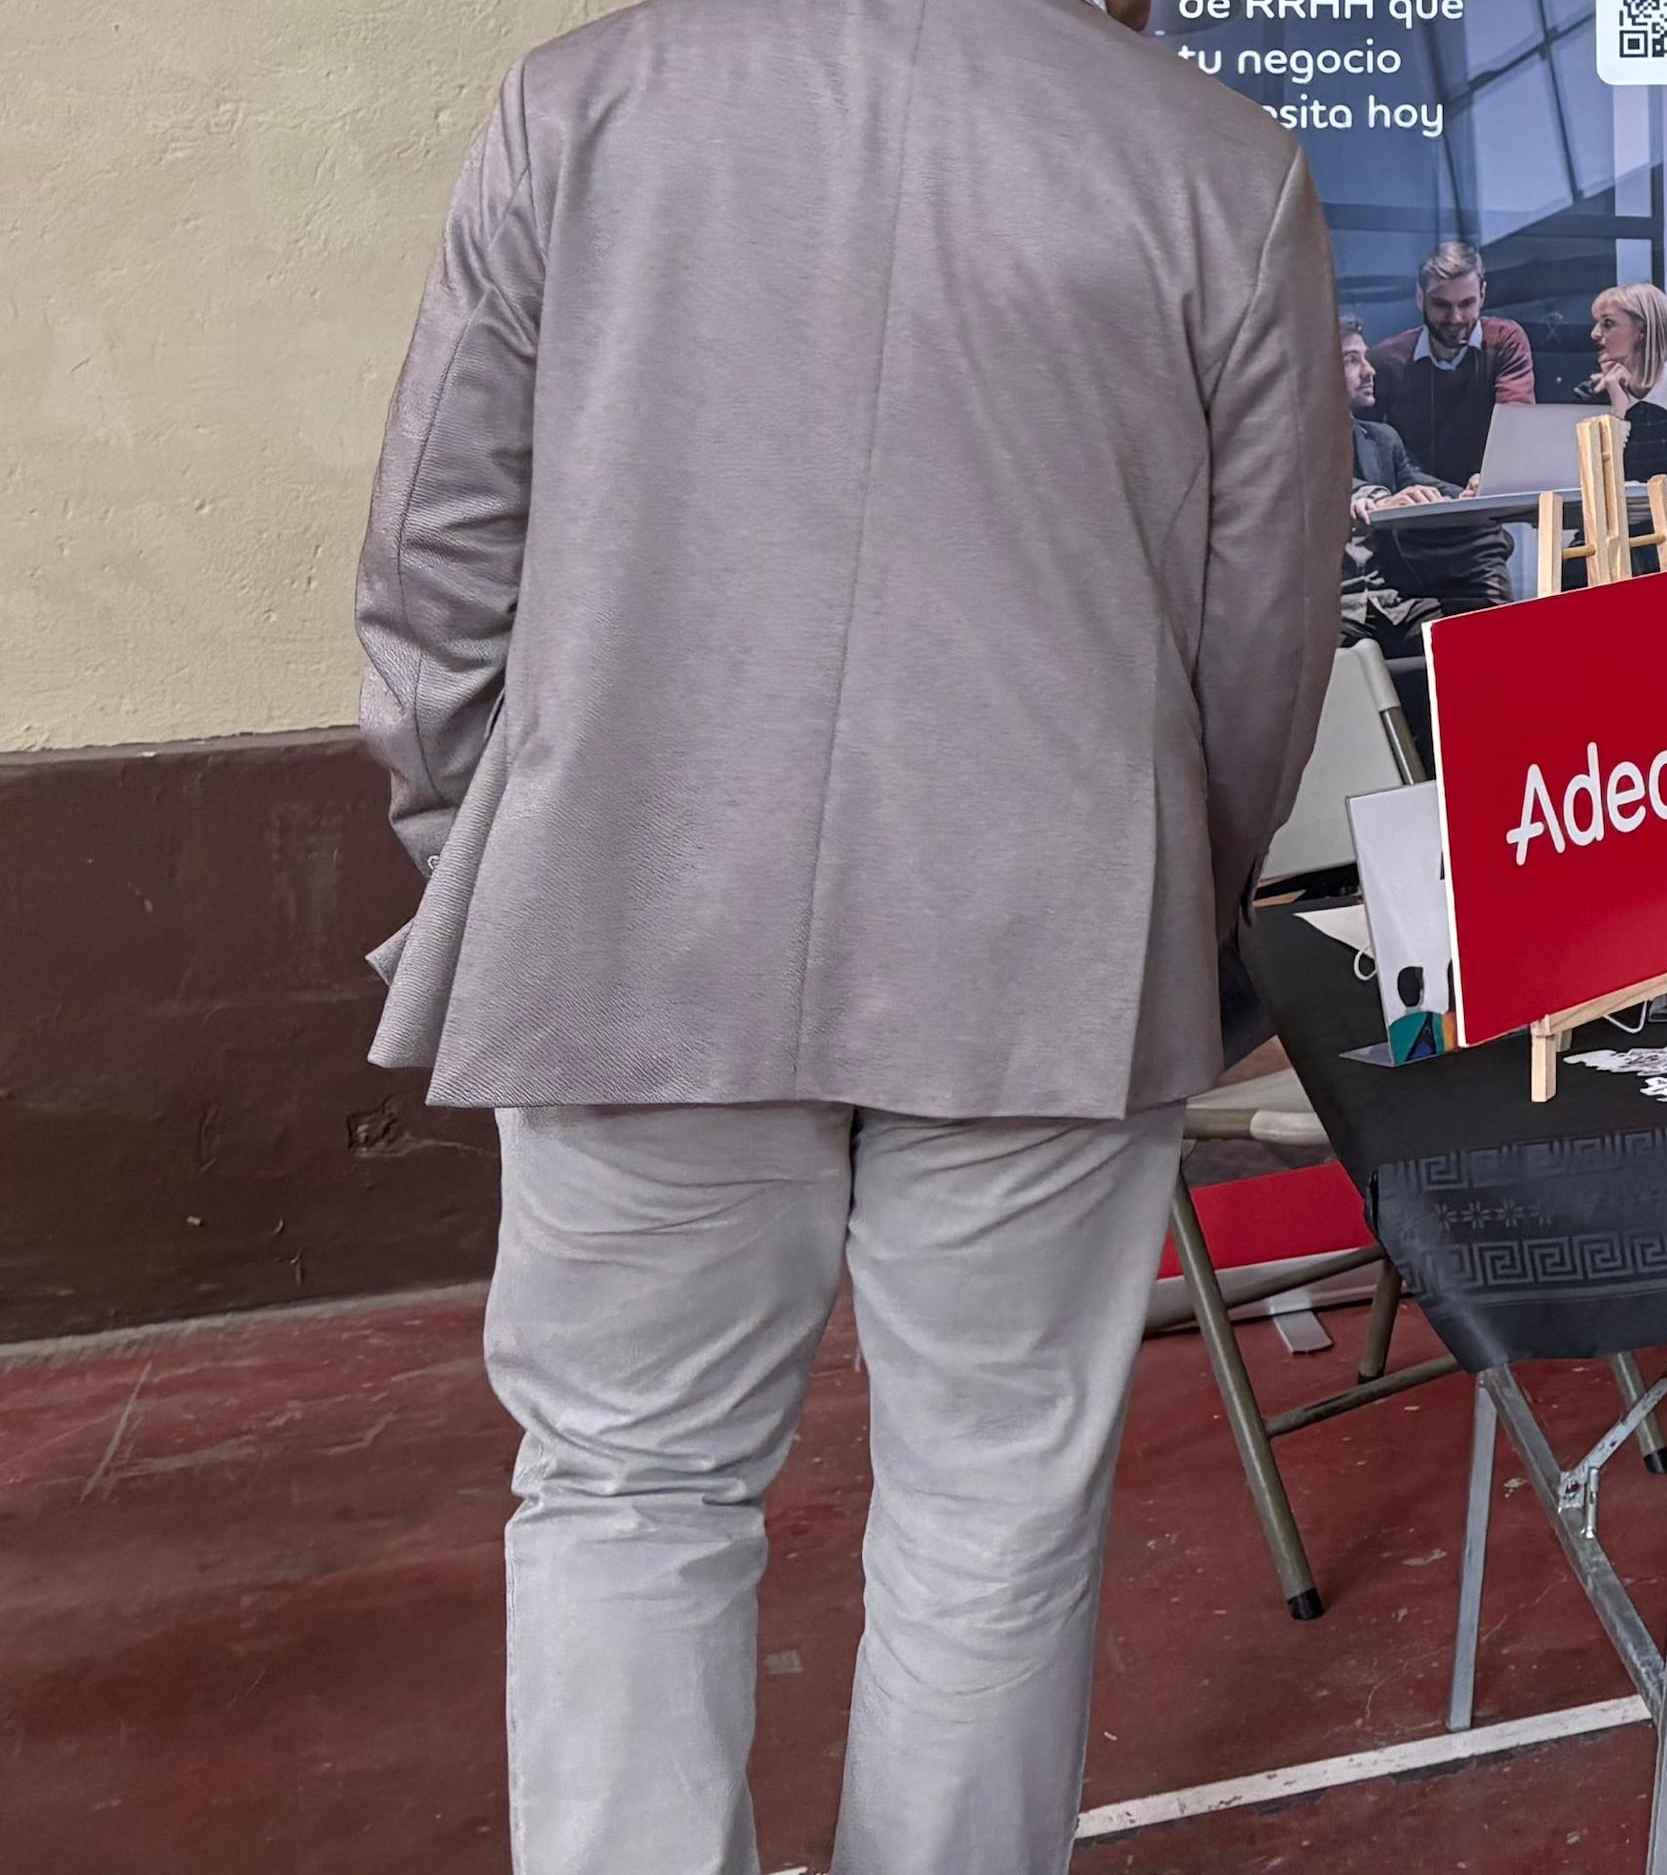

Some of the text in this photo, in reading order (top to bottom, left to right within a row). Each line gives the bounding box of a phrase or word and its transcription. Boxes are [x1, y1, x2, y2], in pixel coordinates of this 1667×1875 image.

[1237, 38, 1402, 85] negocio
[1262, 93, 1444, 138] sita hoy
